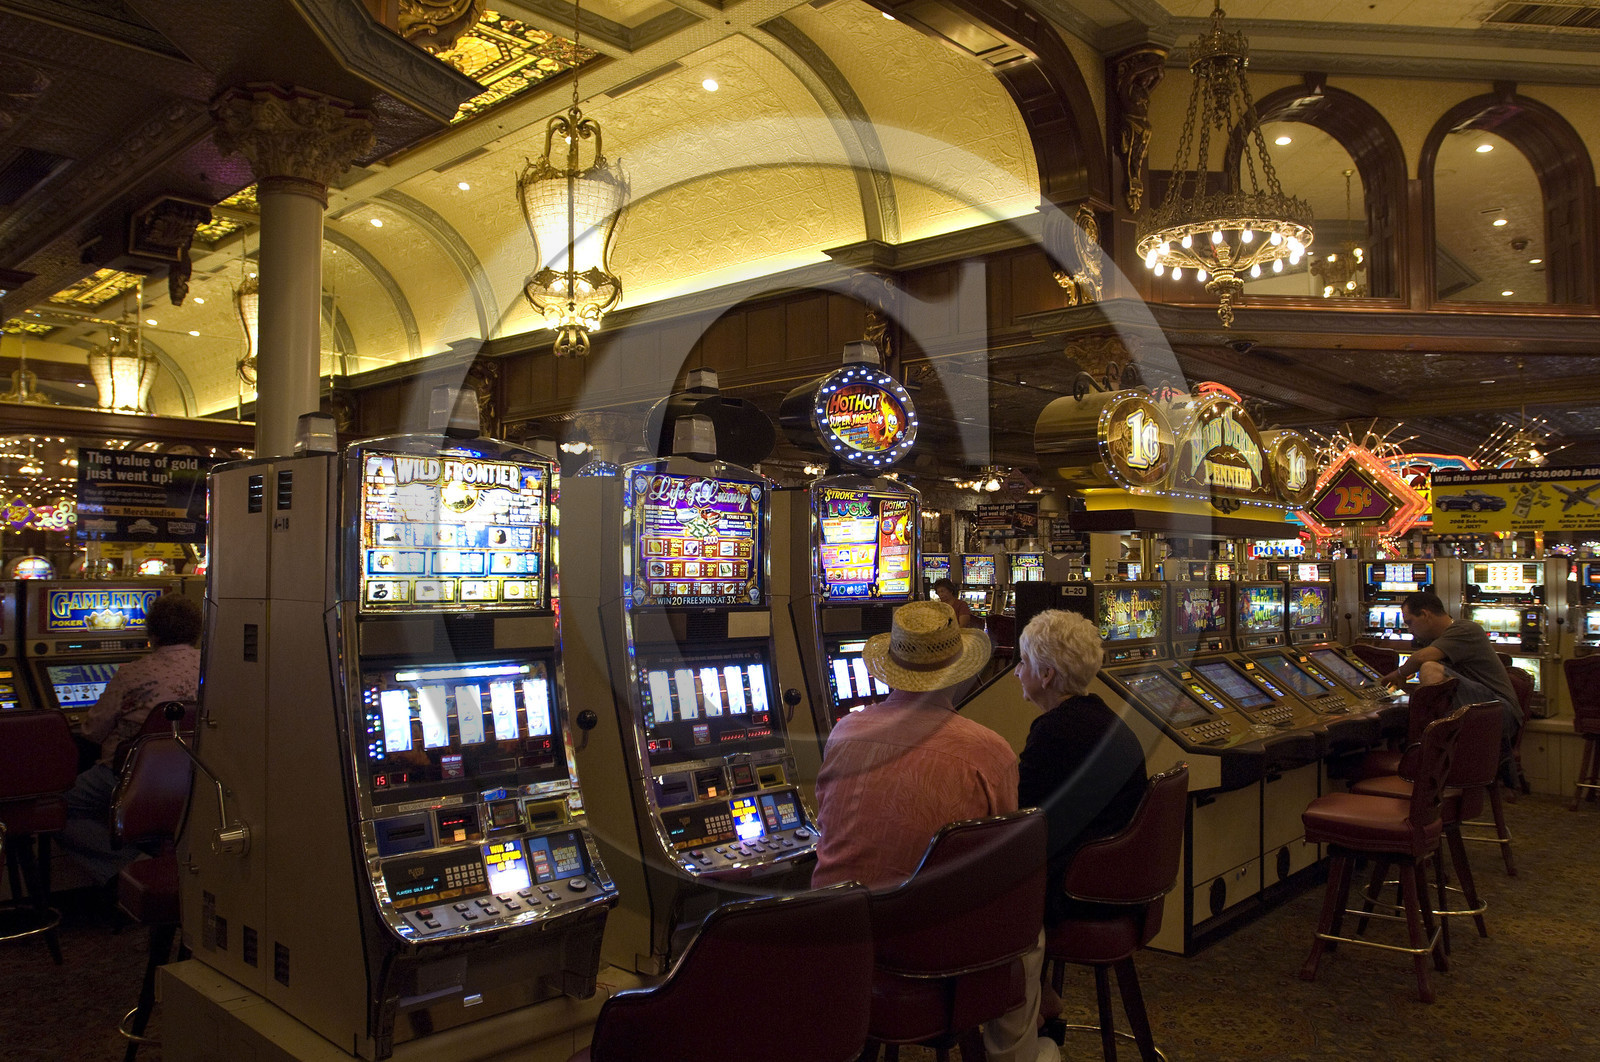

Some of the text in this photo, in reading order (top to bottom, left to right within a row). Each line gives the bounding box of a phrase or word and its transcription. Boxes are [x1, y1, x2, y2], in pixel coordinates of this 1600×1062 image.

[86, 451, 198, 471] The value of gold
[86, 467, 173, 485] just went up!
[395, 457, 519, 489] WILD FRONTIER
[1434, 475, 1451, 483] Win
[1453, 474, 1470, 482] this
[1499, 471, 1525, 480] JULY
[1530, 469, 1570, 478] $30,000
[1572, 468, 1581, 476] in
[825, 489, 859, 502] STROKE
[123, 507, 176, 517] Merchandise
[828, 502, 872, 518] LUCK
[1064, 587, 1084, 595] 4-20
[51, 591, 110, 619] GAME
[656, 597, 672, 605] WIN
[672, 596, 683, 605] 20
[699, 596, 716, 604] SPINS
[717, 596, 725, 604] AT
[726, 595, 737, 604] 3X
[543, 740, 551, 748] 15
[376, 776, 386, 786] 15
